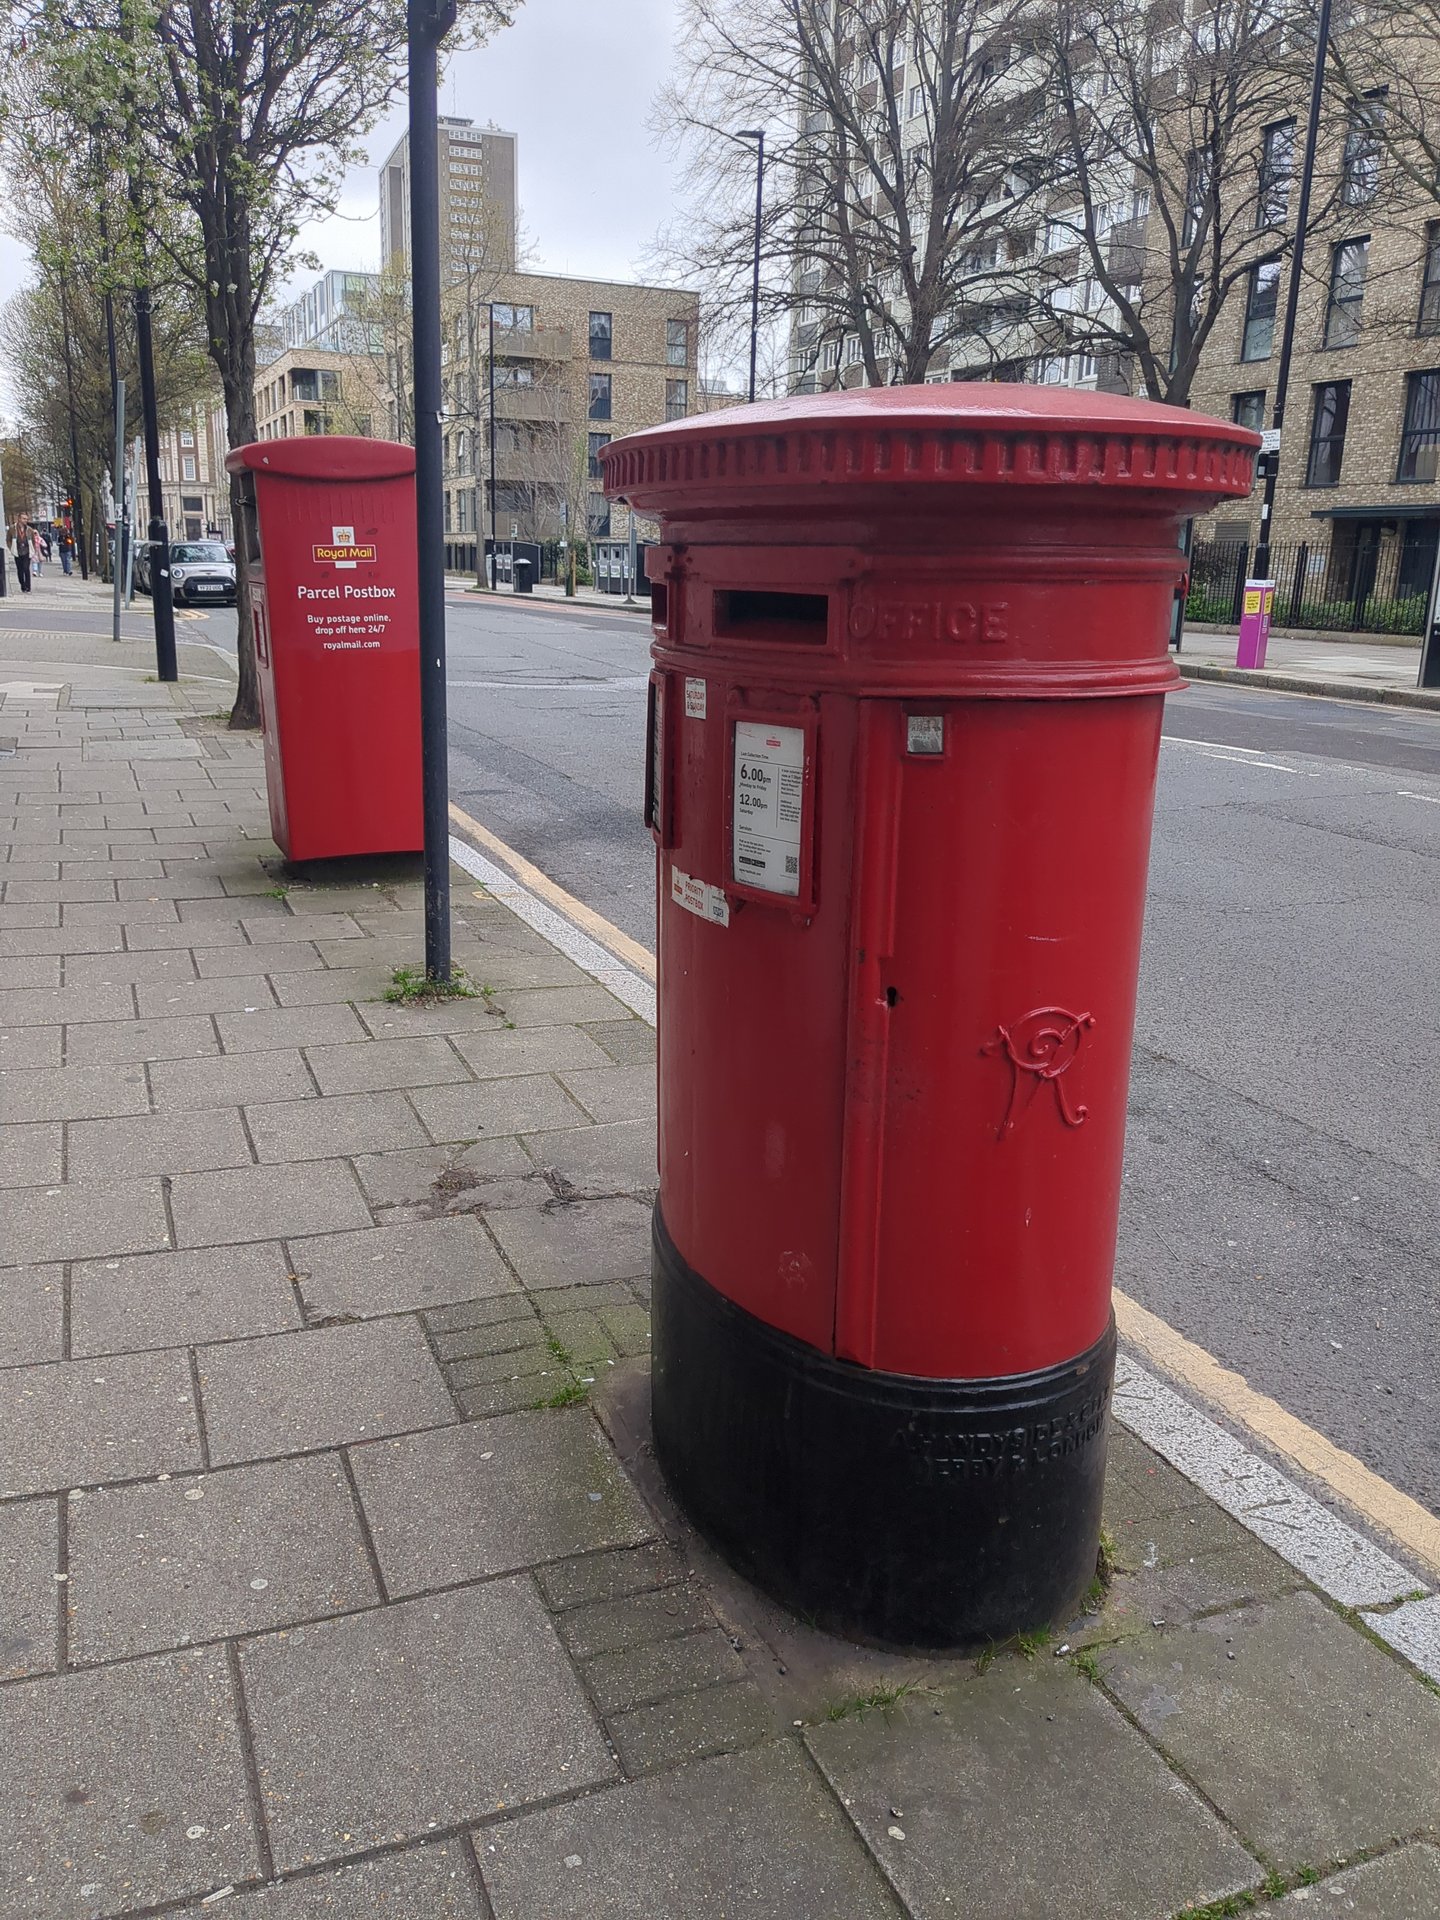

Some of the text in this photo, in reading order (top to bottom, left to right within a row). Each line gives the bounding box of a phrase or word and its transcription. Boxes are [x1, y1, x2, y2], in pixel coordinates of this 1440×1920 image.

[317, 547, 372, 560] Royal Mail
[297, 585, 396, 599] Parcel Postbox
[307, 615, 324, 625] Buy
[327, 615, 361, 625] postage
[849, 601, 1009, 642] OFFICE
[315, 624, 386, 635] drop off here 24/7
[323, 640, 381, 650] royalmail.com
[740, 763, 772, 784] 6.00pm
[739, 793, 769, 810] 12.00pm
